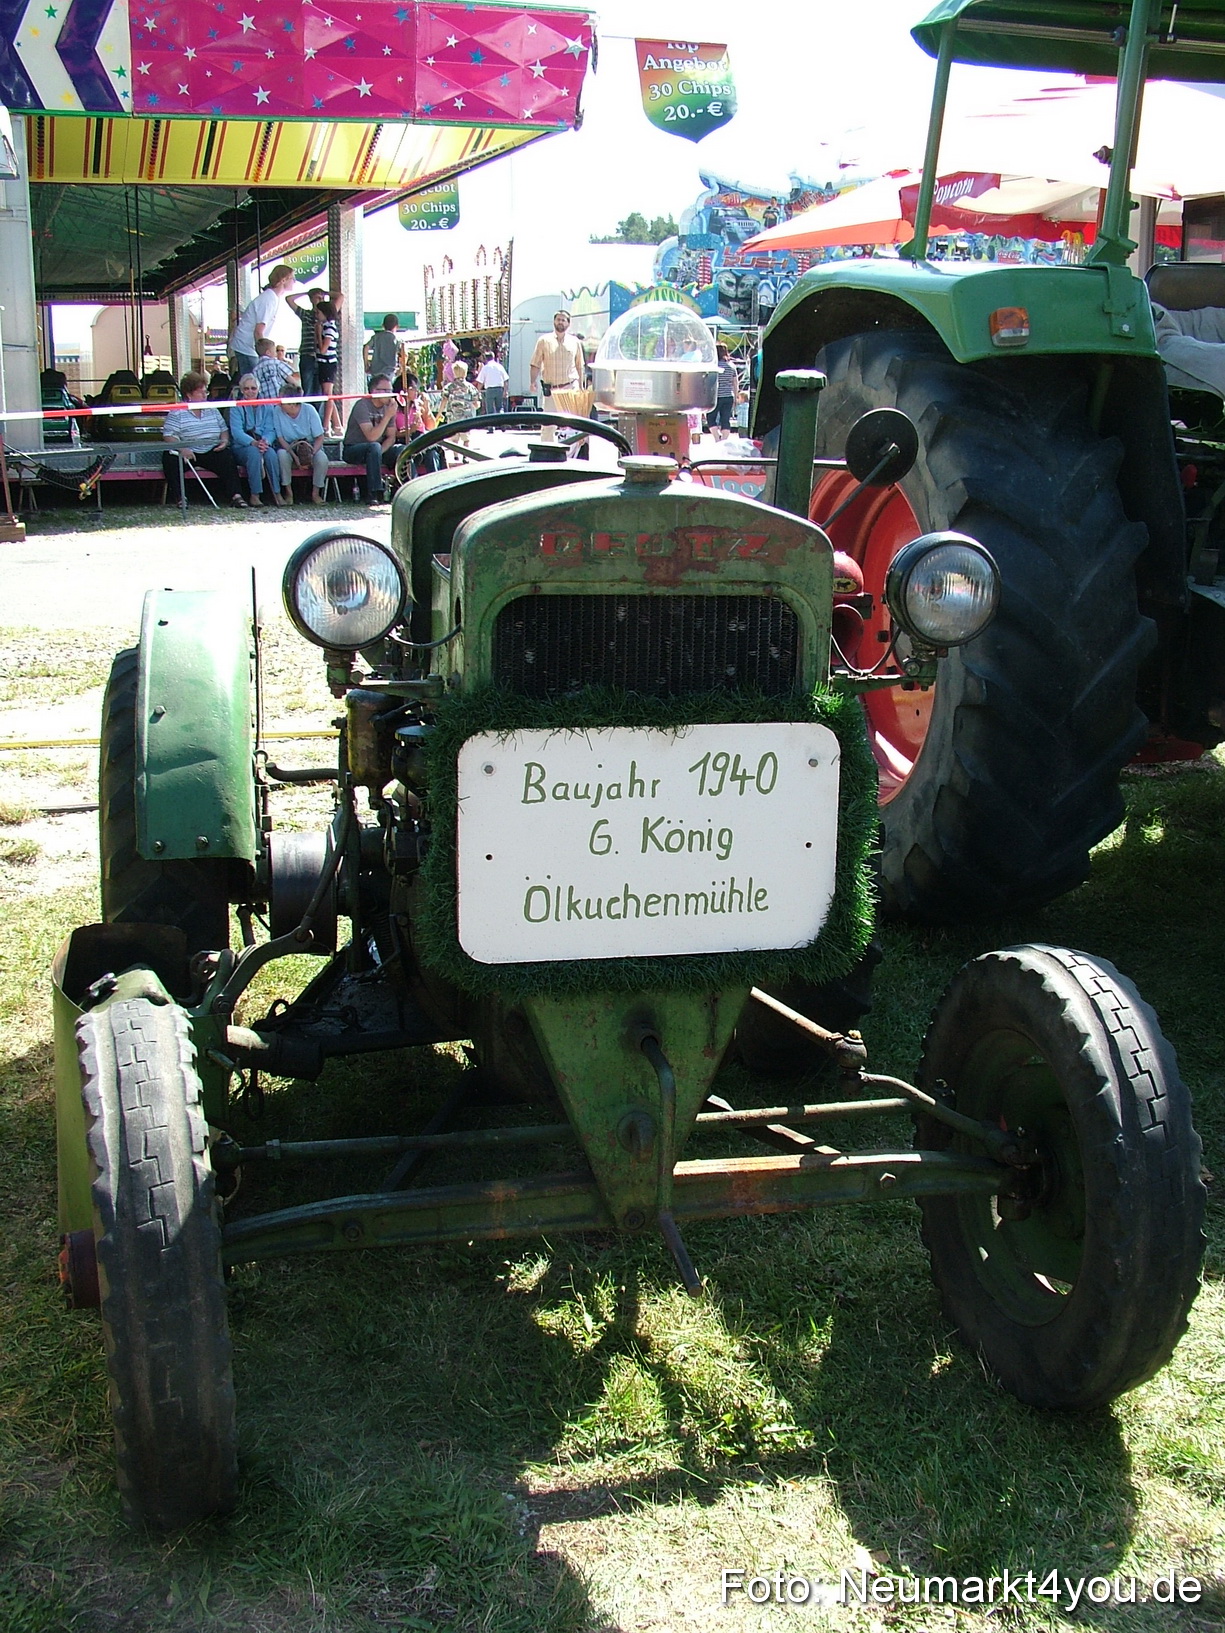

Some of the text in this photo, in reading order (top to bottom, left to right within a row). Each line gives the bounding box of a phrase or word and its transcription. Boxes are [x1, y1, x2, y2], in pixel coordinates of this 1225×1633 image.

[643, 54, 729, 72] Angebot
[649, 79, 731, 100] 30 Chips
[402, 201, 456, 215] 30 Chips
[300, 254, 325, 263] Chips
[521, 751, 779, 808] Baujahr 1940
[588, 815, 734, 861] G. König
[522, 873, 770, 924] Ölkuchenmühle
